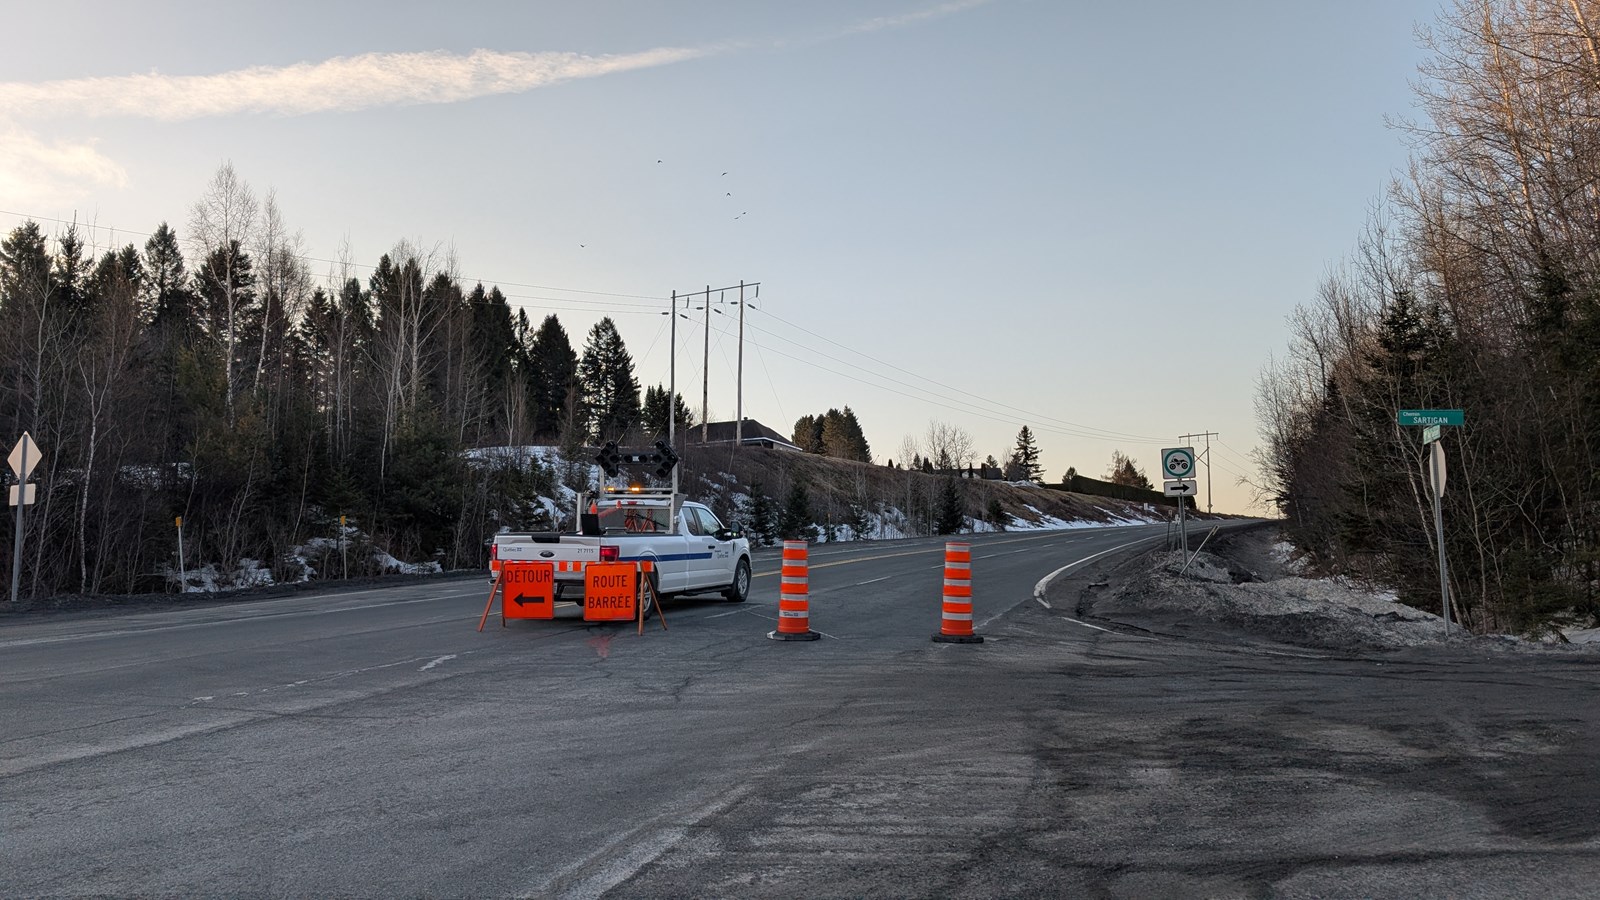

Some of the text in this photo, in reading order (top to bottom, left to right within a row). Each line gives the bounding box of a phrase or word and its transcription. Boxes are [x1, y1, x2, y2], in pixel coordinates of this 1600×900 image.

[1413, 416, 1448, 424] SARTIGAN
[506, 567, 551, 583] DÉTOUR
[592, 575, 628, 588] ROUTE
[588, 593, 631, 609] BARRÉE
